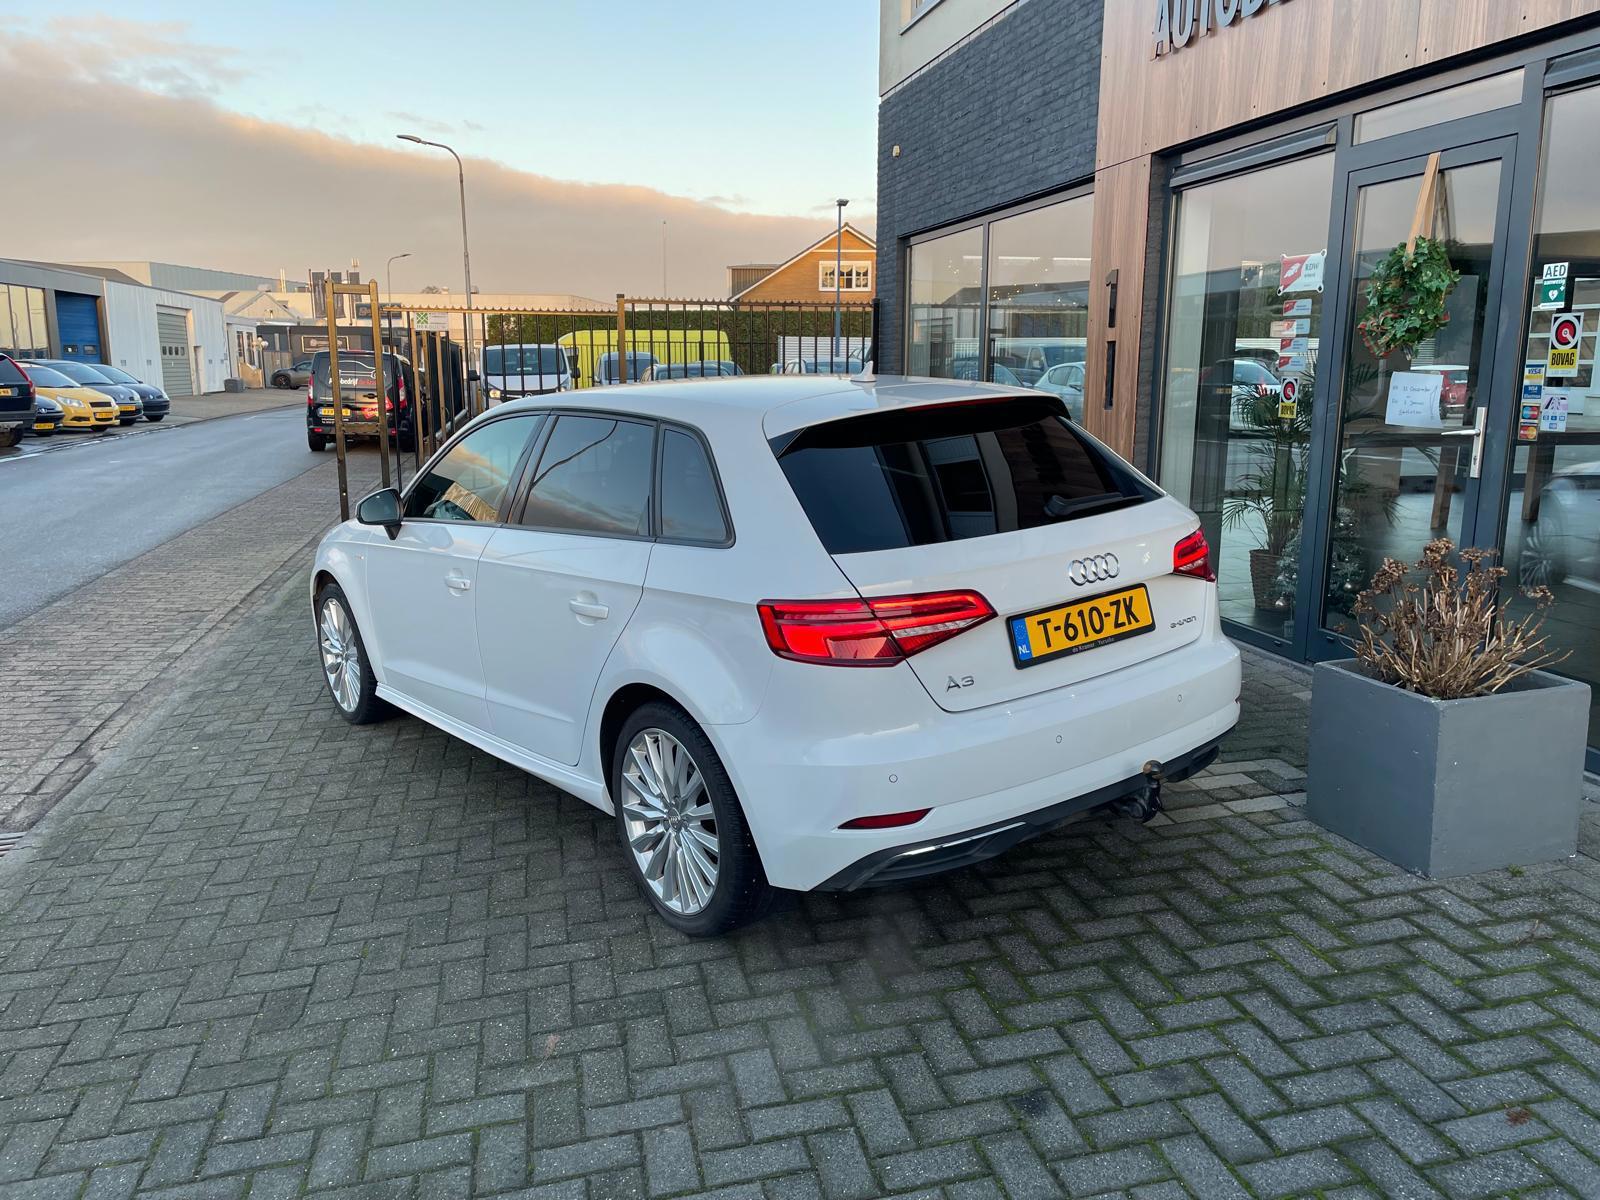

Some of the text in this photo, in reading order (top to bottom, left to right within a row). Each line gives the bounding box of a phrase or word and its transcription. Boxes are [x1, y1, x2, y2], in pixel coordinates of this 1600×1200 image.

[1545, 264, 1567, 278] AED
[1551, 352, 1575, 366] BOVAG
[1037, 595, 1140, 649] T-610-ZK
[1018, 644, 1030, 655] NL
[946, 675, 975, 692] A3
